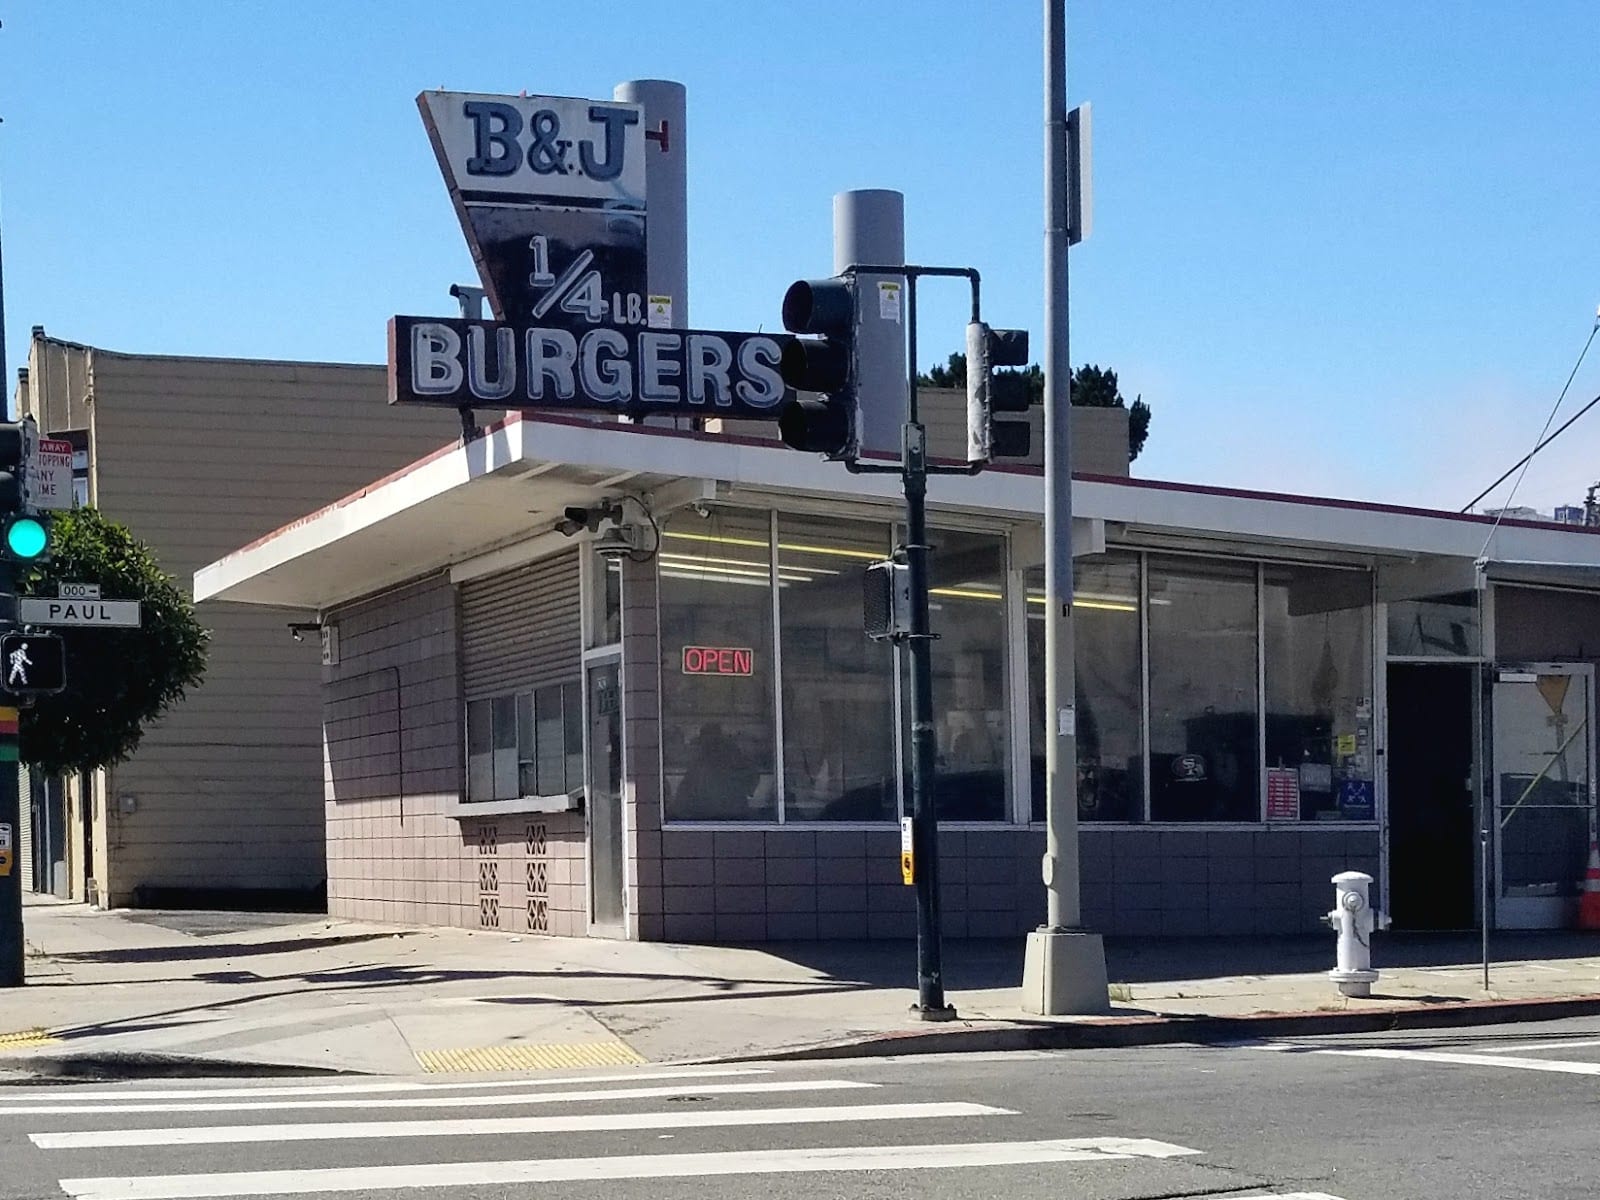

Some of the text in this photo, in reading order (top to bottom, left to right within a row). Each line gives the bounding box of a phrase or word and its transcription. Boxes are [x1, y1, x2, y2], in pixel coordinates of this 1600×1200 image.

[464, 101, 639, 182] B&J
[529, 234, 648, 326] 1/4 LB.
[411, 323, 786, 408] BURGERS
[38, 454, 70, 467] TOPPING
[38, 484, 57, 496] IME
[64, 585, 86, 596] 000
[49, 604, 111, 620] PAUL
[685, 648, 750, 674] OPEN
